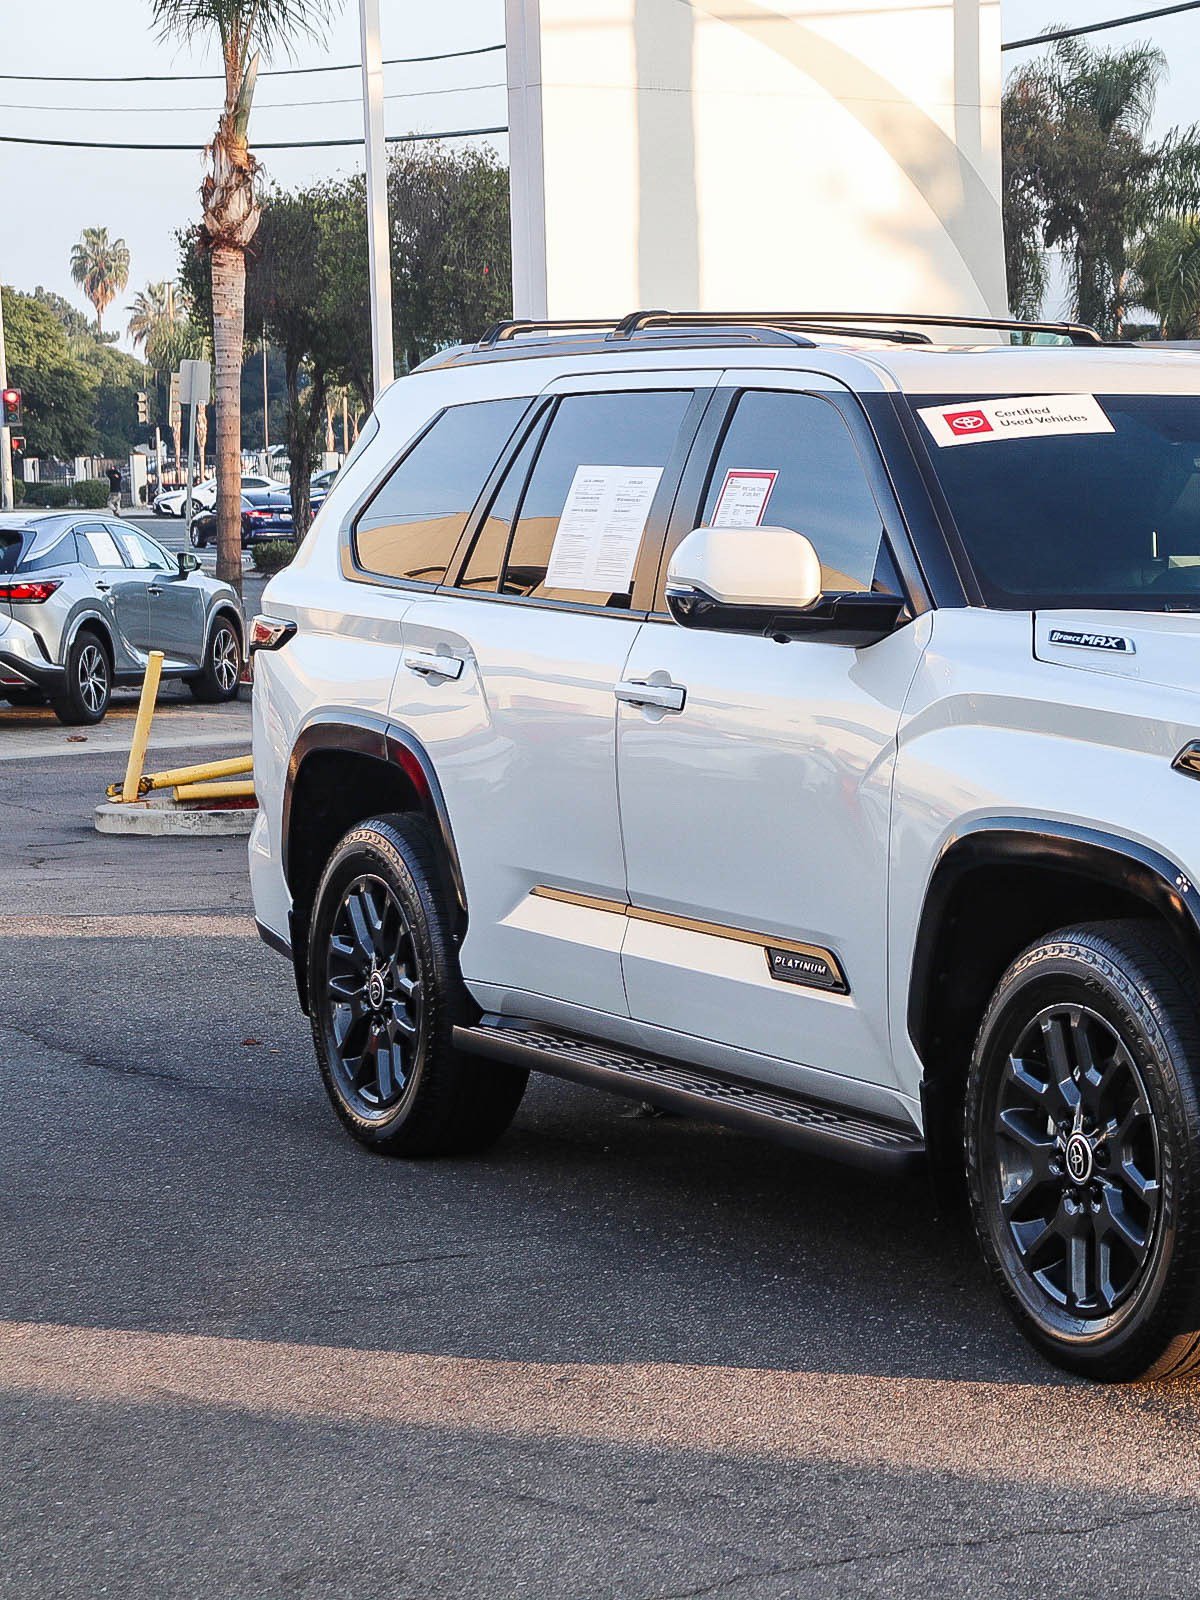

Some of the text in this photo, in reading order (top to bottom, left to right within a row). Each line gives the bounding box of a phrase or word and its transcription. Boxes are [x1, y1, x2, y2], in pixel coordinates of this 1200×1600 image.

[994, 406, 1050, 418] Certified
[1000, 414, 1088, 427] Used Vehicles
[1080, 634, 1120, 648] MAX
[774, 955, 827, 975] PLATINUM
